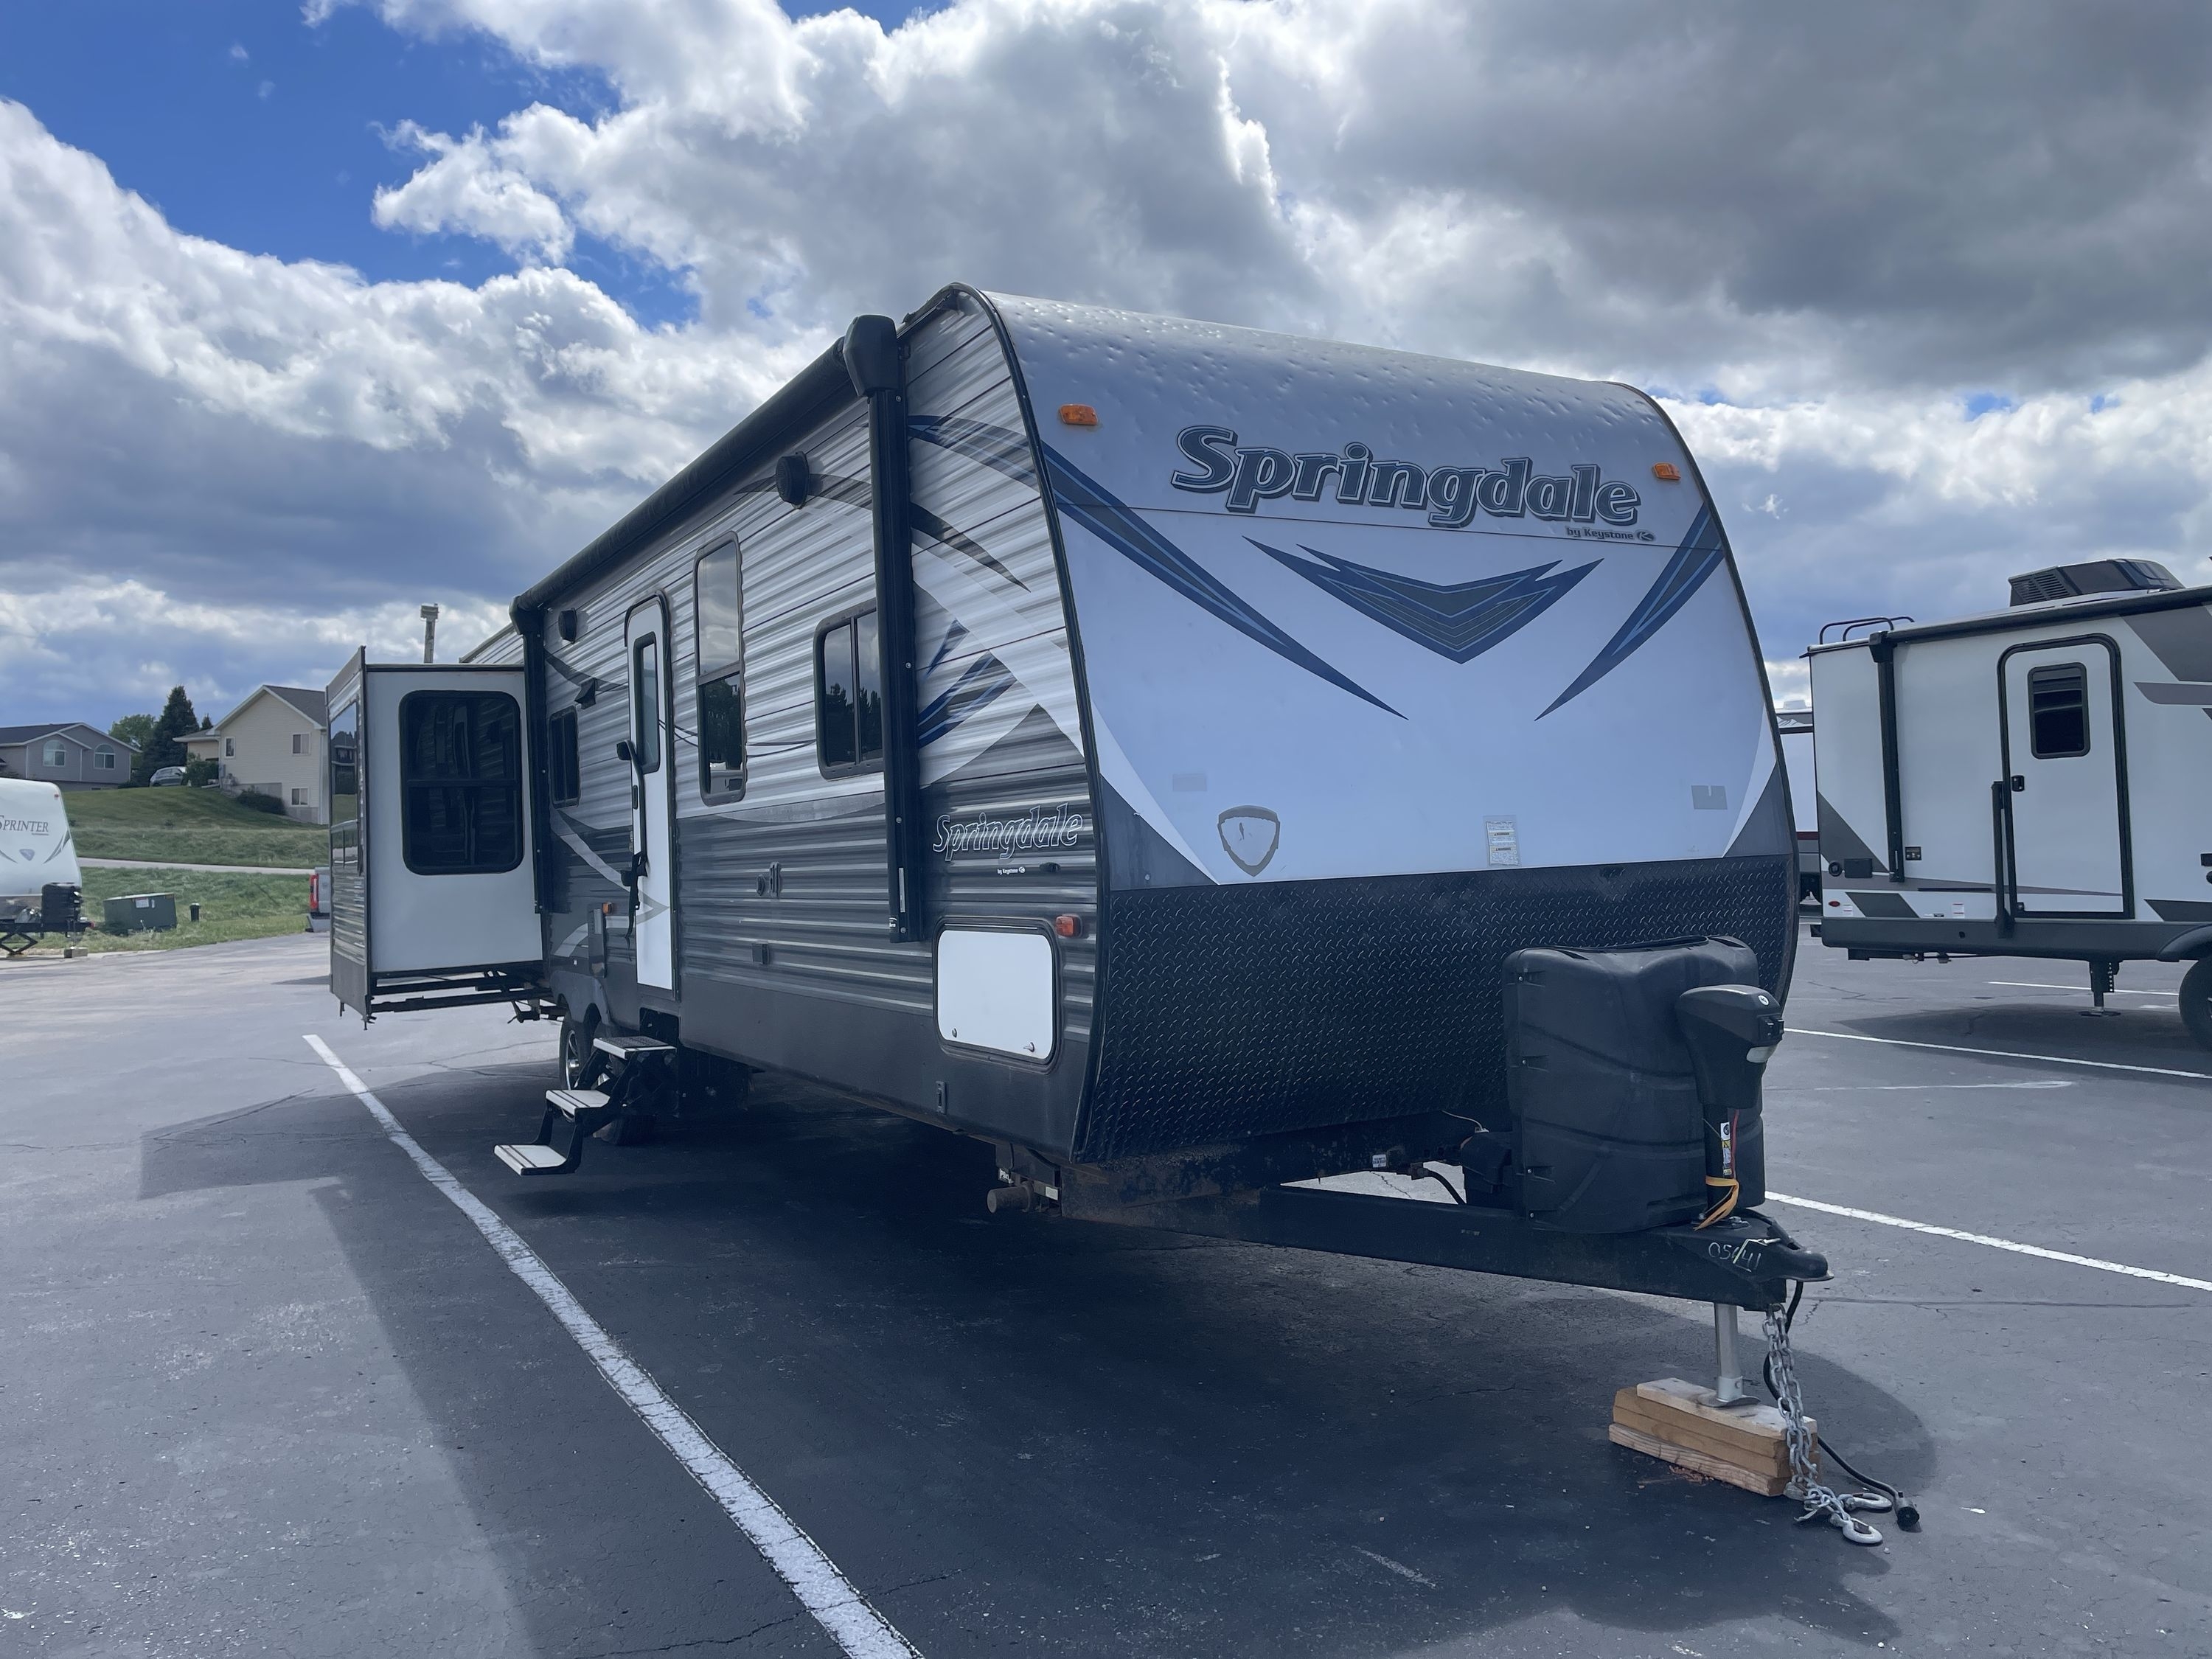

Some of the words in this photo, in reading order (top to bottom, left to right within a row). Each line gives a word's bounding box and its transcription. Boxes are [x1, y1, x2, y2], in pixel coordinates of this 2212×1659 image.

[1172, 425, 1641, 528] Springdale
[1566, 527, 1581, 538] by
[1583, 529, 1634, 540] Keystone
[933, 802, 1082, 861] Springdale
